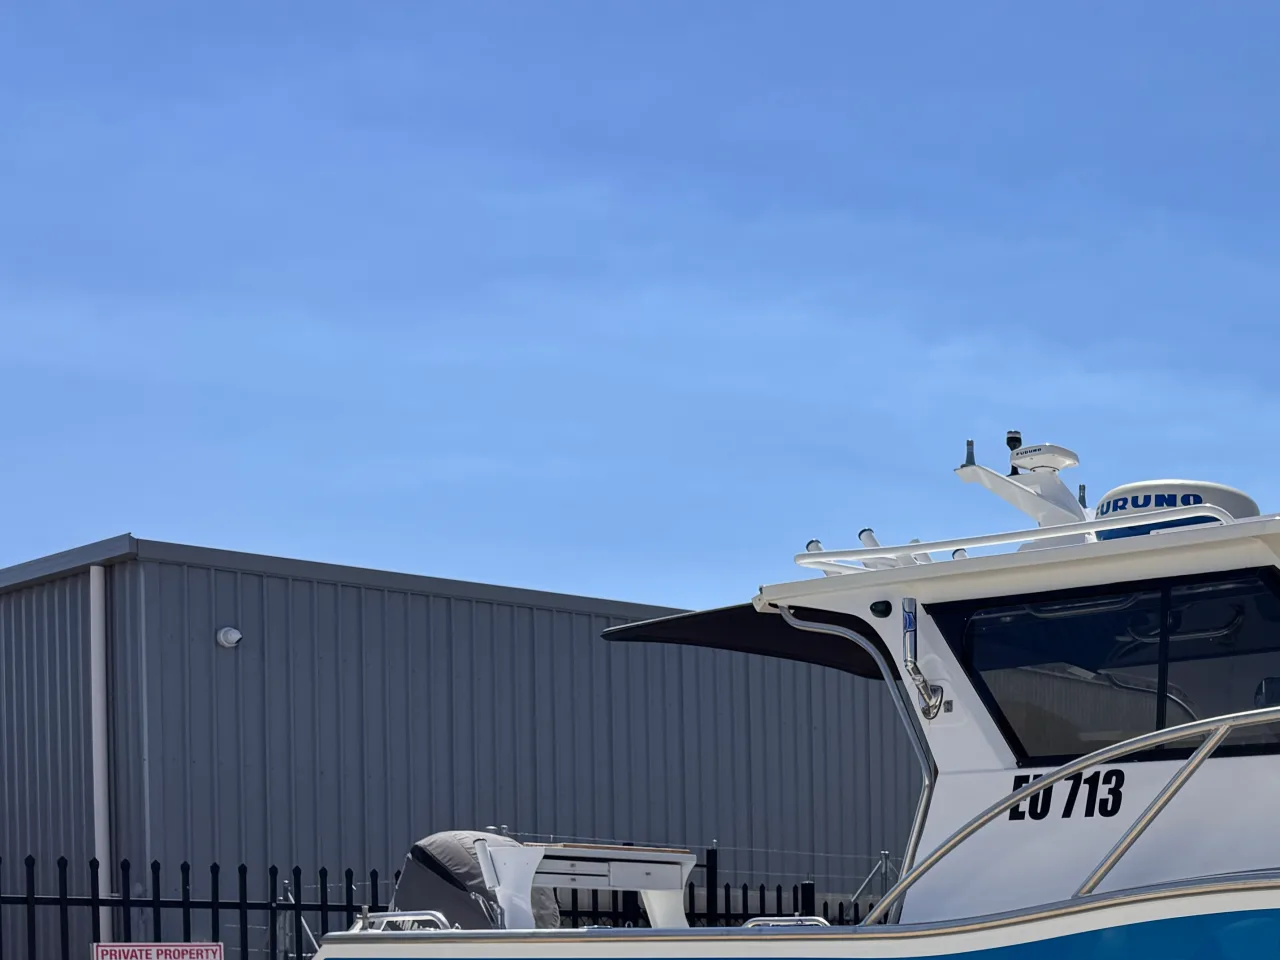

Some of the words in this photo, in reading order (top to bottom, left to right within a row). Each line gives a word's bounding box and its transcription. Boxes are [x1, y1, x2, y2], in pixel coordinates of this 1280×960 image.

[1062, 769, 1125, 818] 713
[101, 949, 152, 960] PRIVATE
[156, 948, 218, 960] PROPERTY
